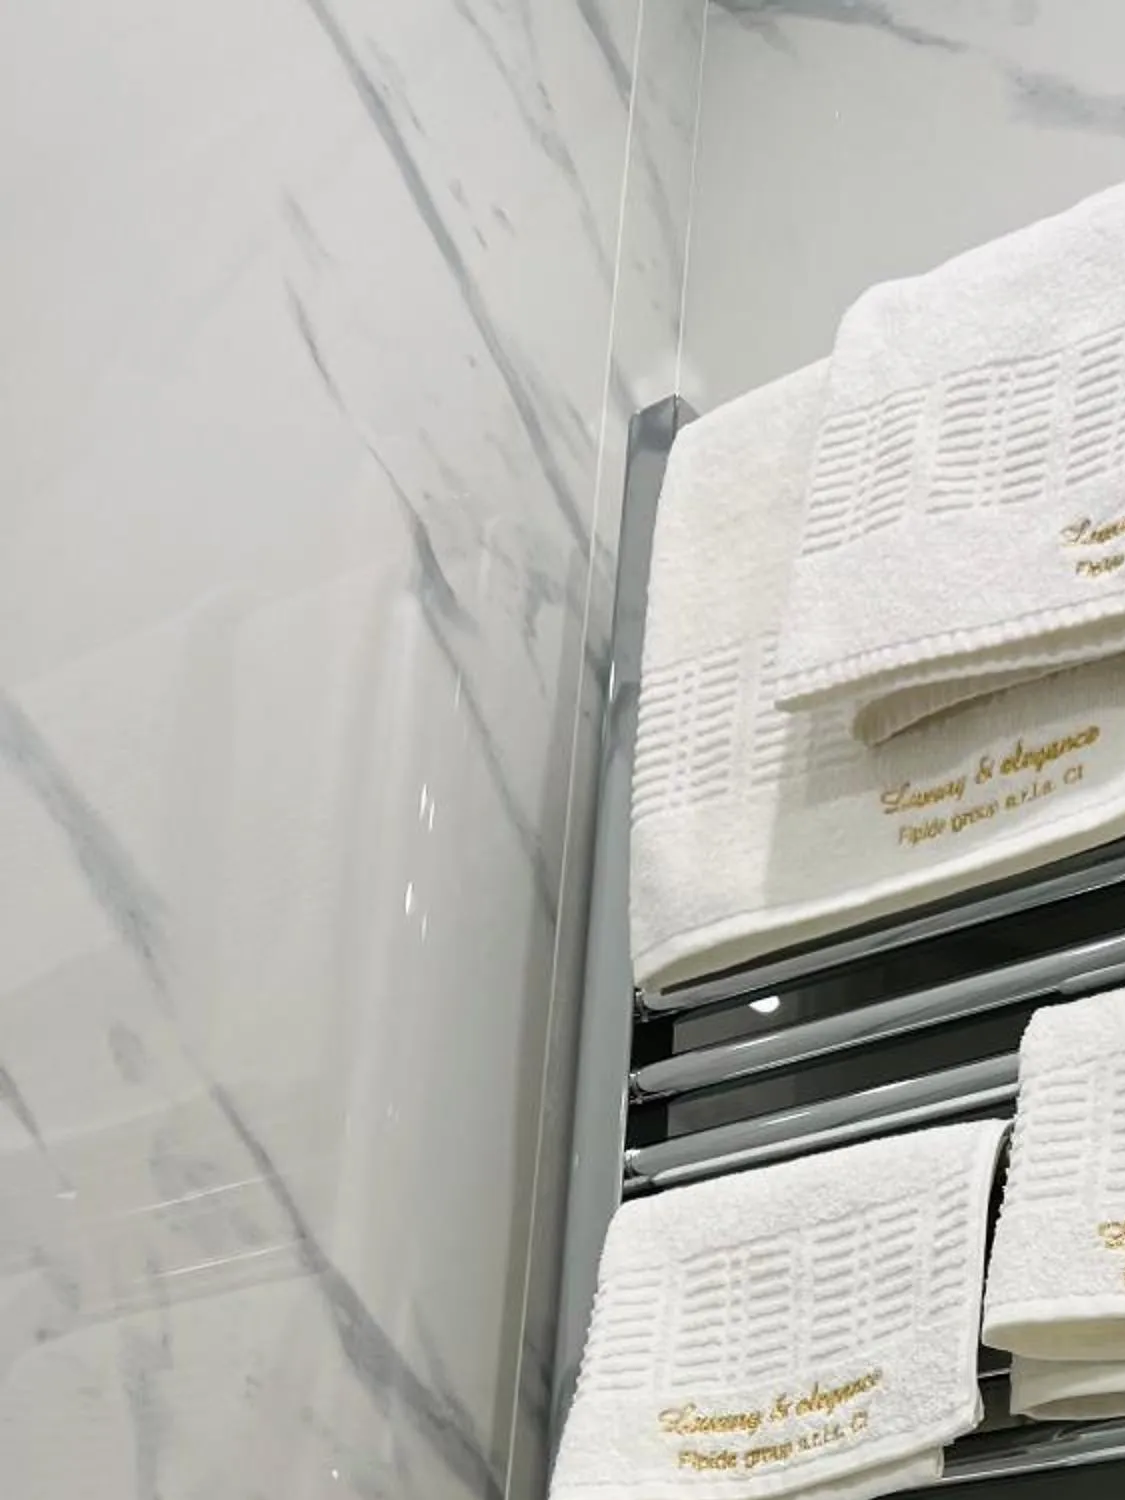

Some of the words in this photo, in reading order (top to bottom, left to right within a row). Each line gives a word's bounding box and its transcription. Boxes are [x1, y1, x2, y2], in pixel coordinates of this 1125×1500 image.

[881, 775, 967, 815] Luxury
[975, 756, 994, 785] &
[1000, 724, 1101, 776] elegance
[950, 798, 999, 832] group
[658, 1403, 761, 1435] Luxury
[770, 1392, 792, 1422] &
[796, 1367, 884, 1415] elegance
[744, 1442, 793, 1469] group
